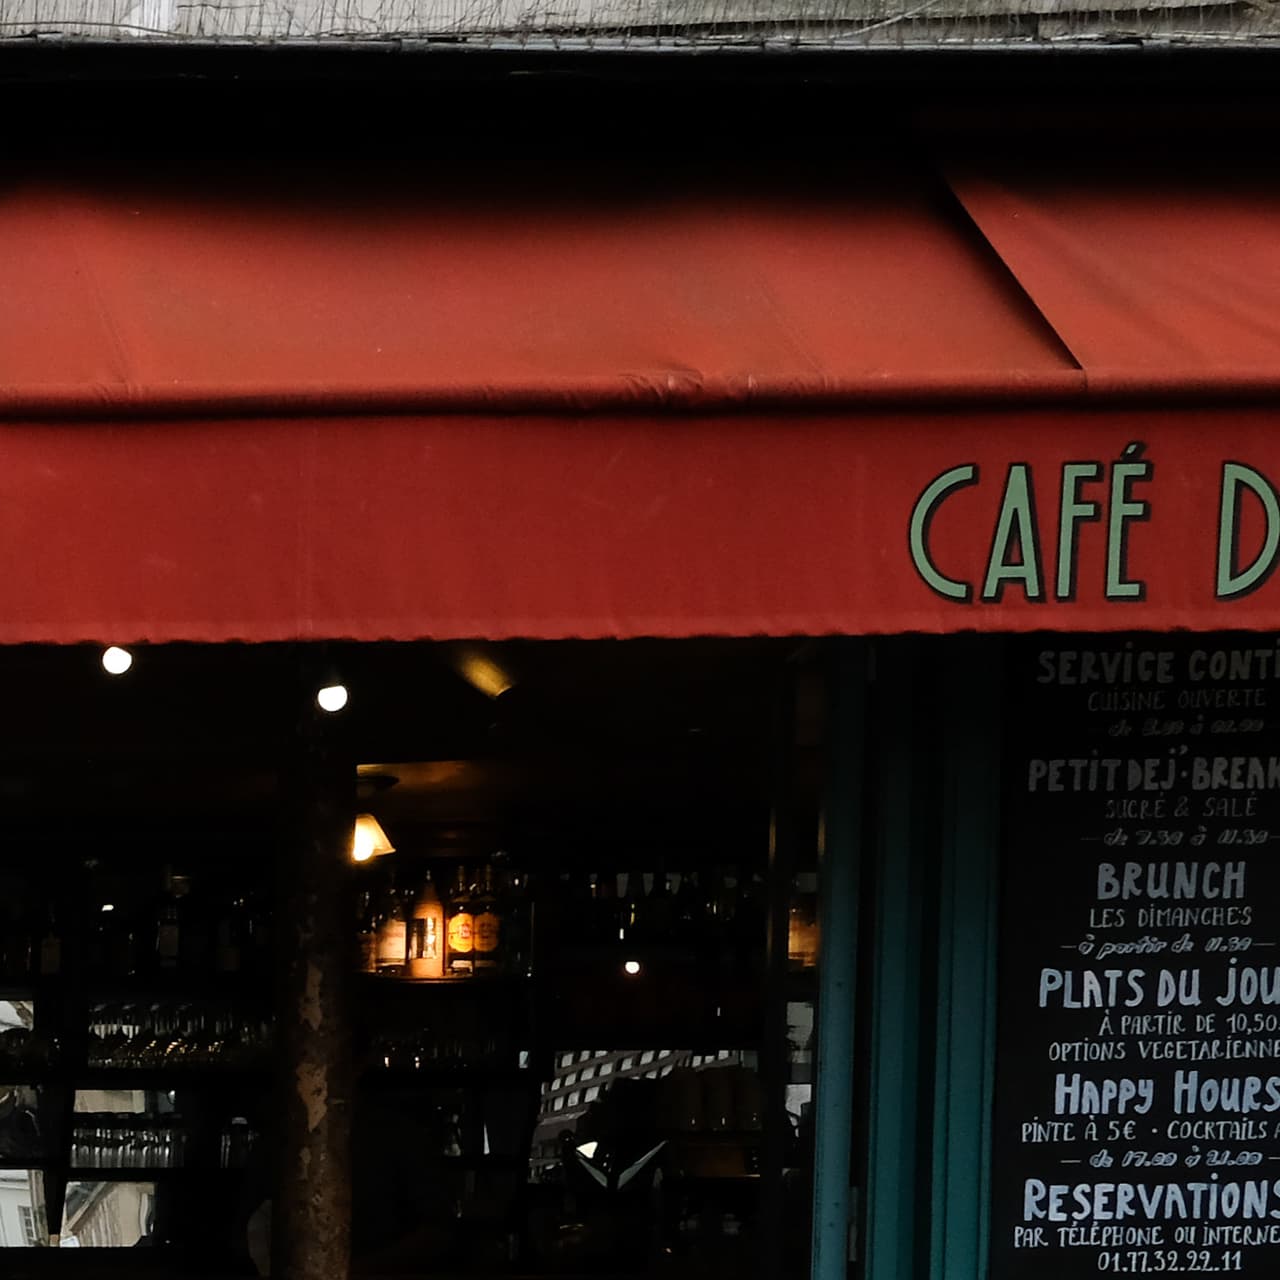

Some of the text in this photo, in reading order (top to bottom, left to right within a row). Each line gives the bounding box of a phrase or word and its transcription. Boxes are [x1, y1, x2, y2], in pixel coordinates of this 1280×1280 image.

[908, 441, 1153, 604] CAFÉ
[1036, 641, 1176, 685] SERVICE
[1028, 747, 1123, 793] PETIT
[1105, 790, 1259, 819] SUCRÉ & SALÉ
[1096, 861, 1247, 901] BRUNCH
[1088, 907, 1126, 929] LES
[1095, 935, 1169, 961] partir
[1038, 967, 1147, 1009] PLATS
[1156, 968, 1203, 1008] DU
[1097, 1009, 1115, 1036] À
[1120, 1010, 1187, 1036] PARTIR
[1195, 1013, 1217, 1035] DE
[1048, 1037, 1127, 1062] OPTIONS
[1053, 1072, 1156, 1116] HAPPY
[1021, 1116, 1077, 1143] PINTE
[1083, 1115, 1100, 1141] À
[1107, 1119, 1138, 1141] 5€
[1166, 1117, 1269, 1141] COCKTAILS
[1023, 1172, 1280, 1222] RESERVATIONS
[1013, 1225, 1050, 1249] PAR
[1056, 1220, 1166, 1248] TÉLÉPHONE
[1174, 1225, 1197, 1246] OU
[1097, 1249, 1243, 1273] 01.77.32.22.11
